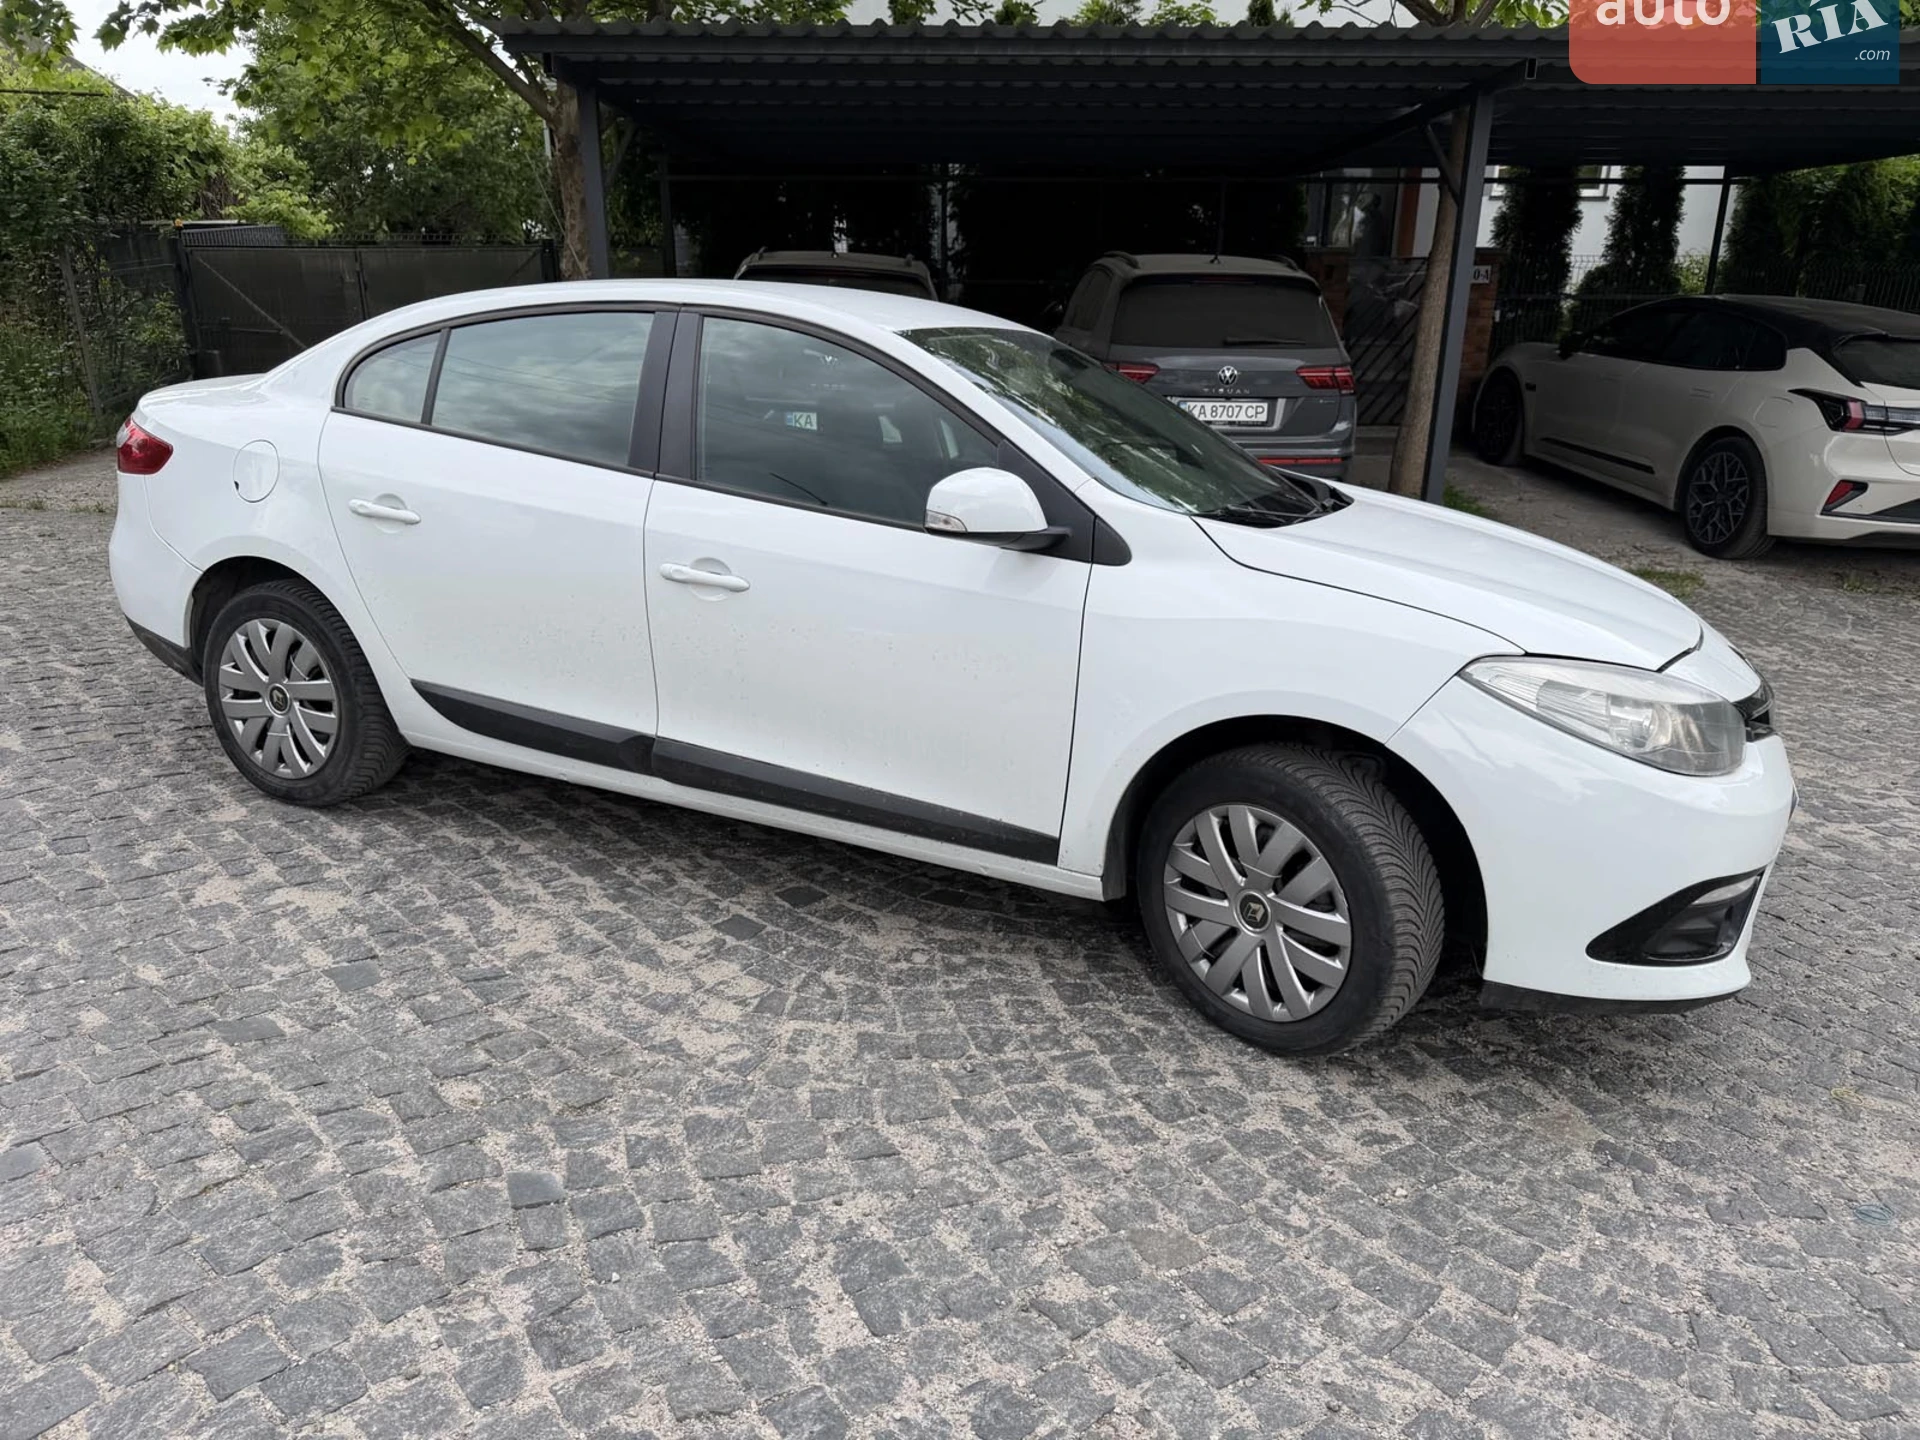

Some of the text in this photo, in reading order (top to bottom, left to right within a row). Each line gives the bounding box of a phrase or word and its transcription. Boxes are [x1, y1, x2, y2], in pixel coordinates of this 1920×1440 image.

[1187, 404, 1265, 419] KA 8707 CP
[794, 413, 814, 428] KA
